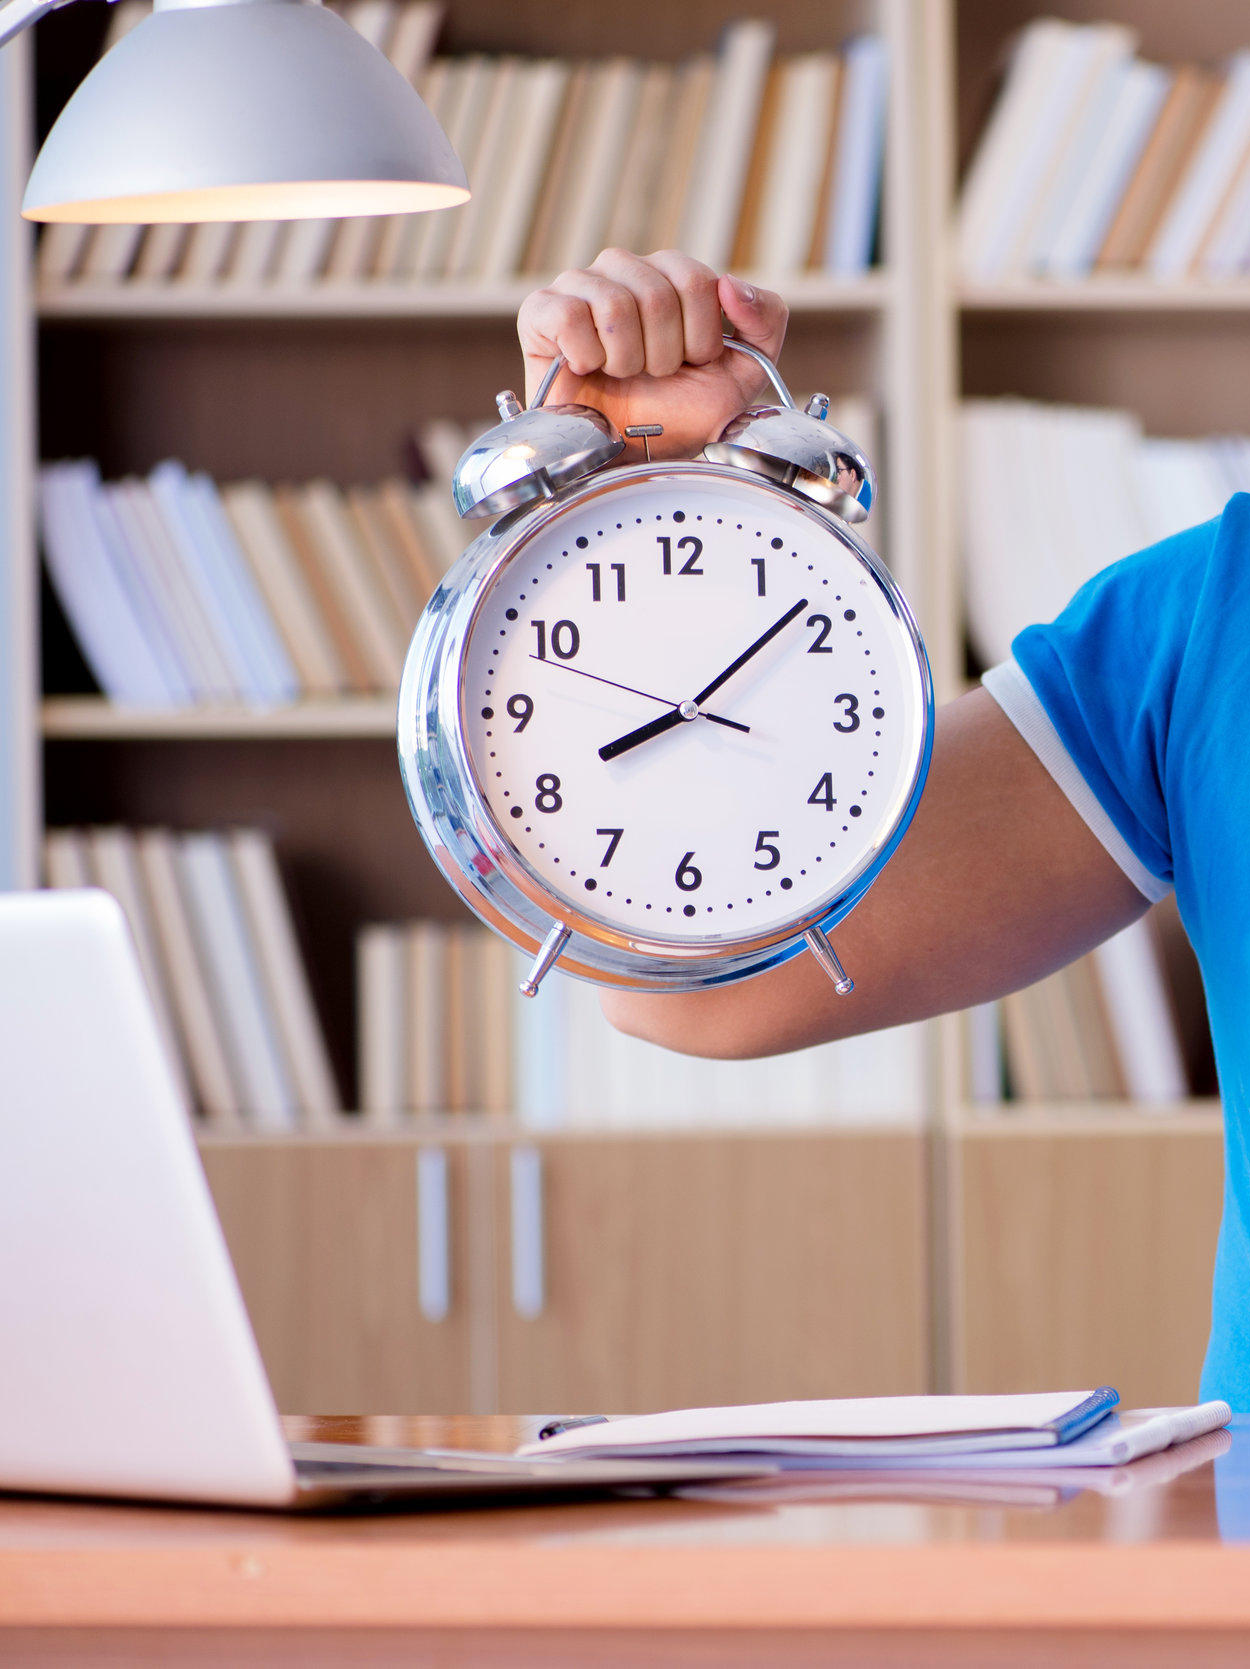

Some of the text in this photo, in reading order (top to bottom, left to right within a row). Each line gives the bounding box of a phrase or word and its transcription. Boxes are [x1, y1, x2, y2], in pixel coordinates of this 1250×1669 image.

[656, 535, 704, 576] 12
[585, 563, 626, 602] 11
[750, 558, 766, 597] 1
[530, 619, 580, 660] 10
[806, 613, 833, 654] 2
[506, 693, 534, 734] 9
[832, 693, 861, 734] 3
[534, 773, 563, 814] 8
[807, 772, 838, 812] 4
[596, 828, 625, 868] 7
[753, 830, 781, 871] 5
[674, 851, 703, 892] 6
